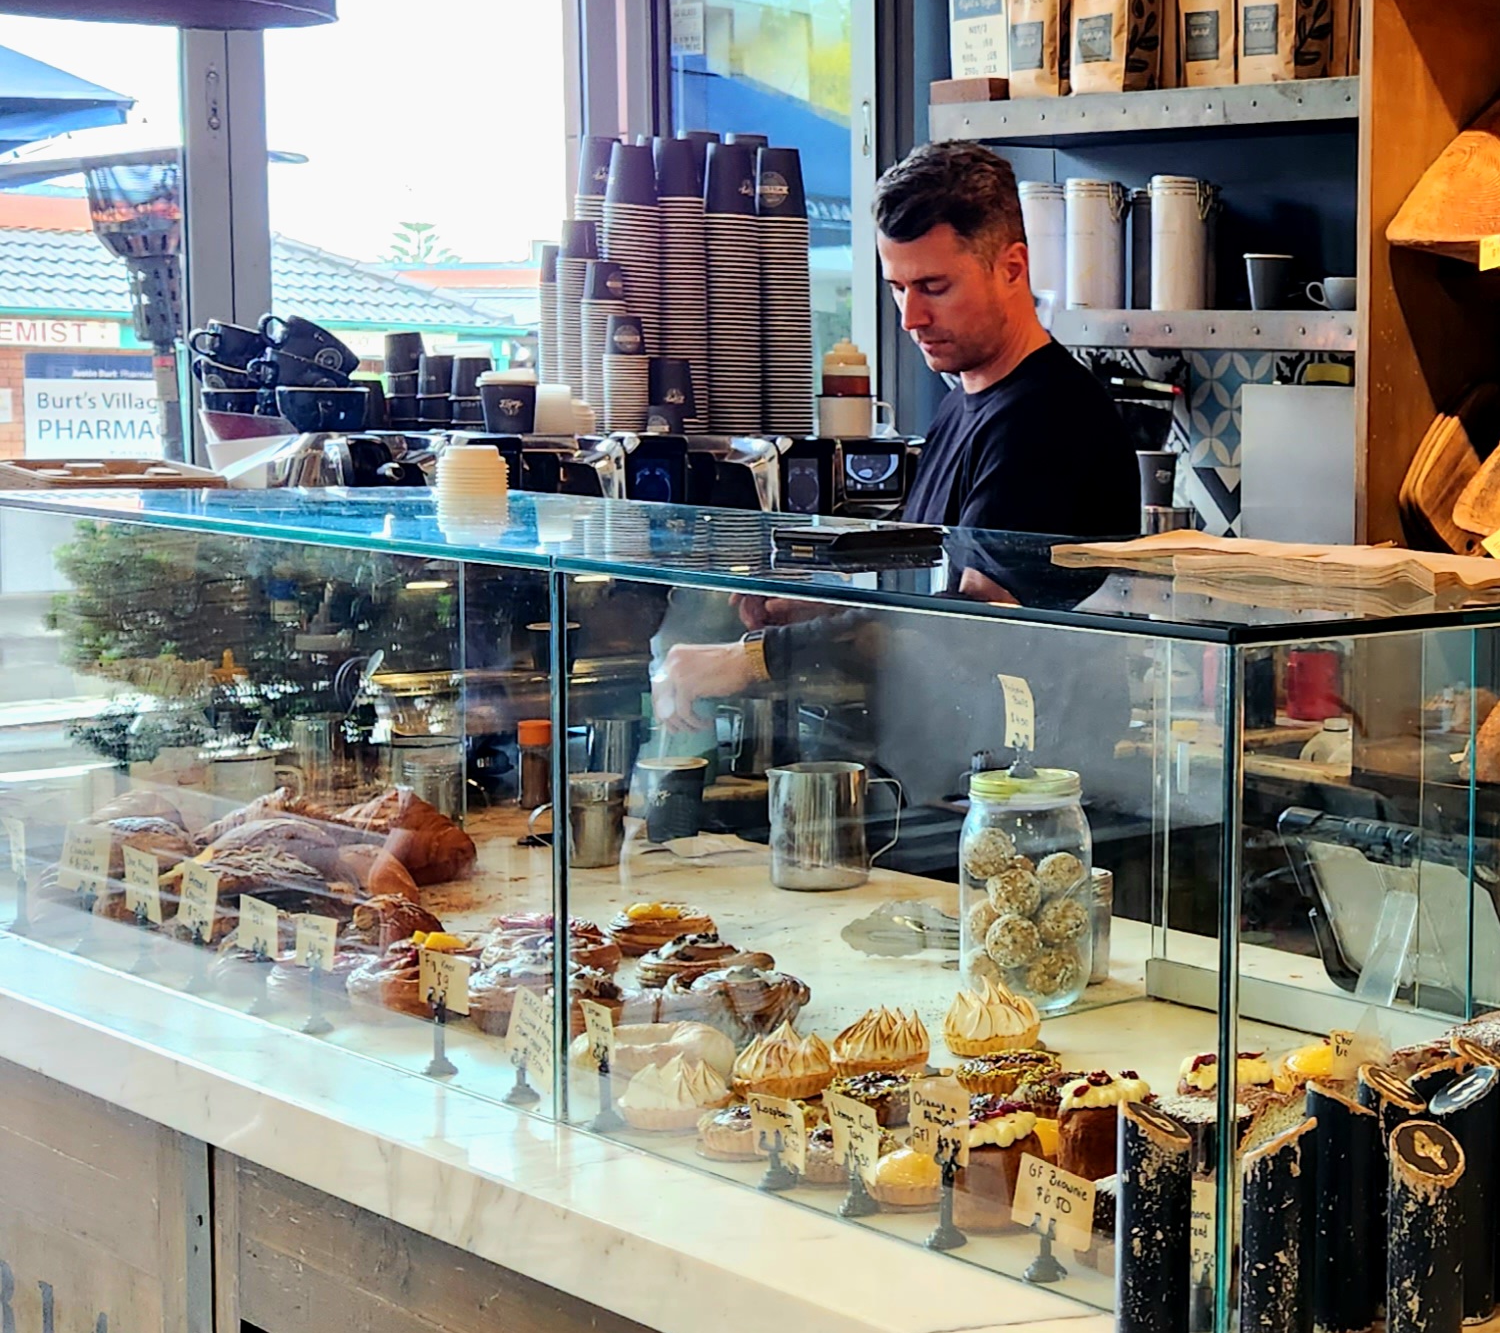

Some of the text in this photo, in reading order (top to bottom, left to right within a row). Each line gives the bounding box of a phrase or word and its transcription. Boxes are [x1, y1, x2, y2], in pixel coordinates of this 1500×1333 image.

[37, 391, 97, 410] Burt's
[1028, 1162, 1088, 1202] GF Brownie
